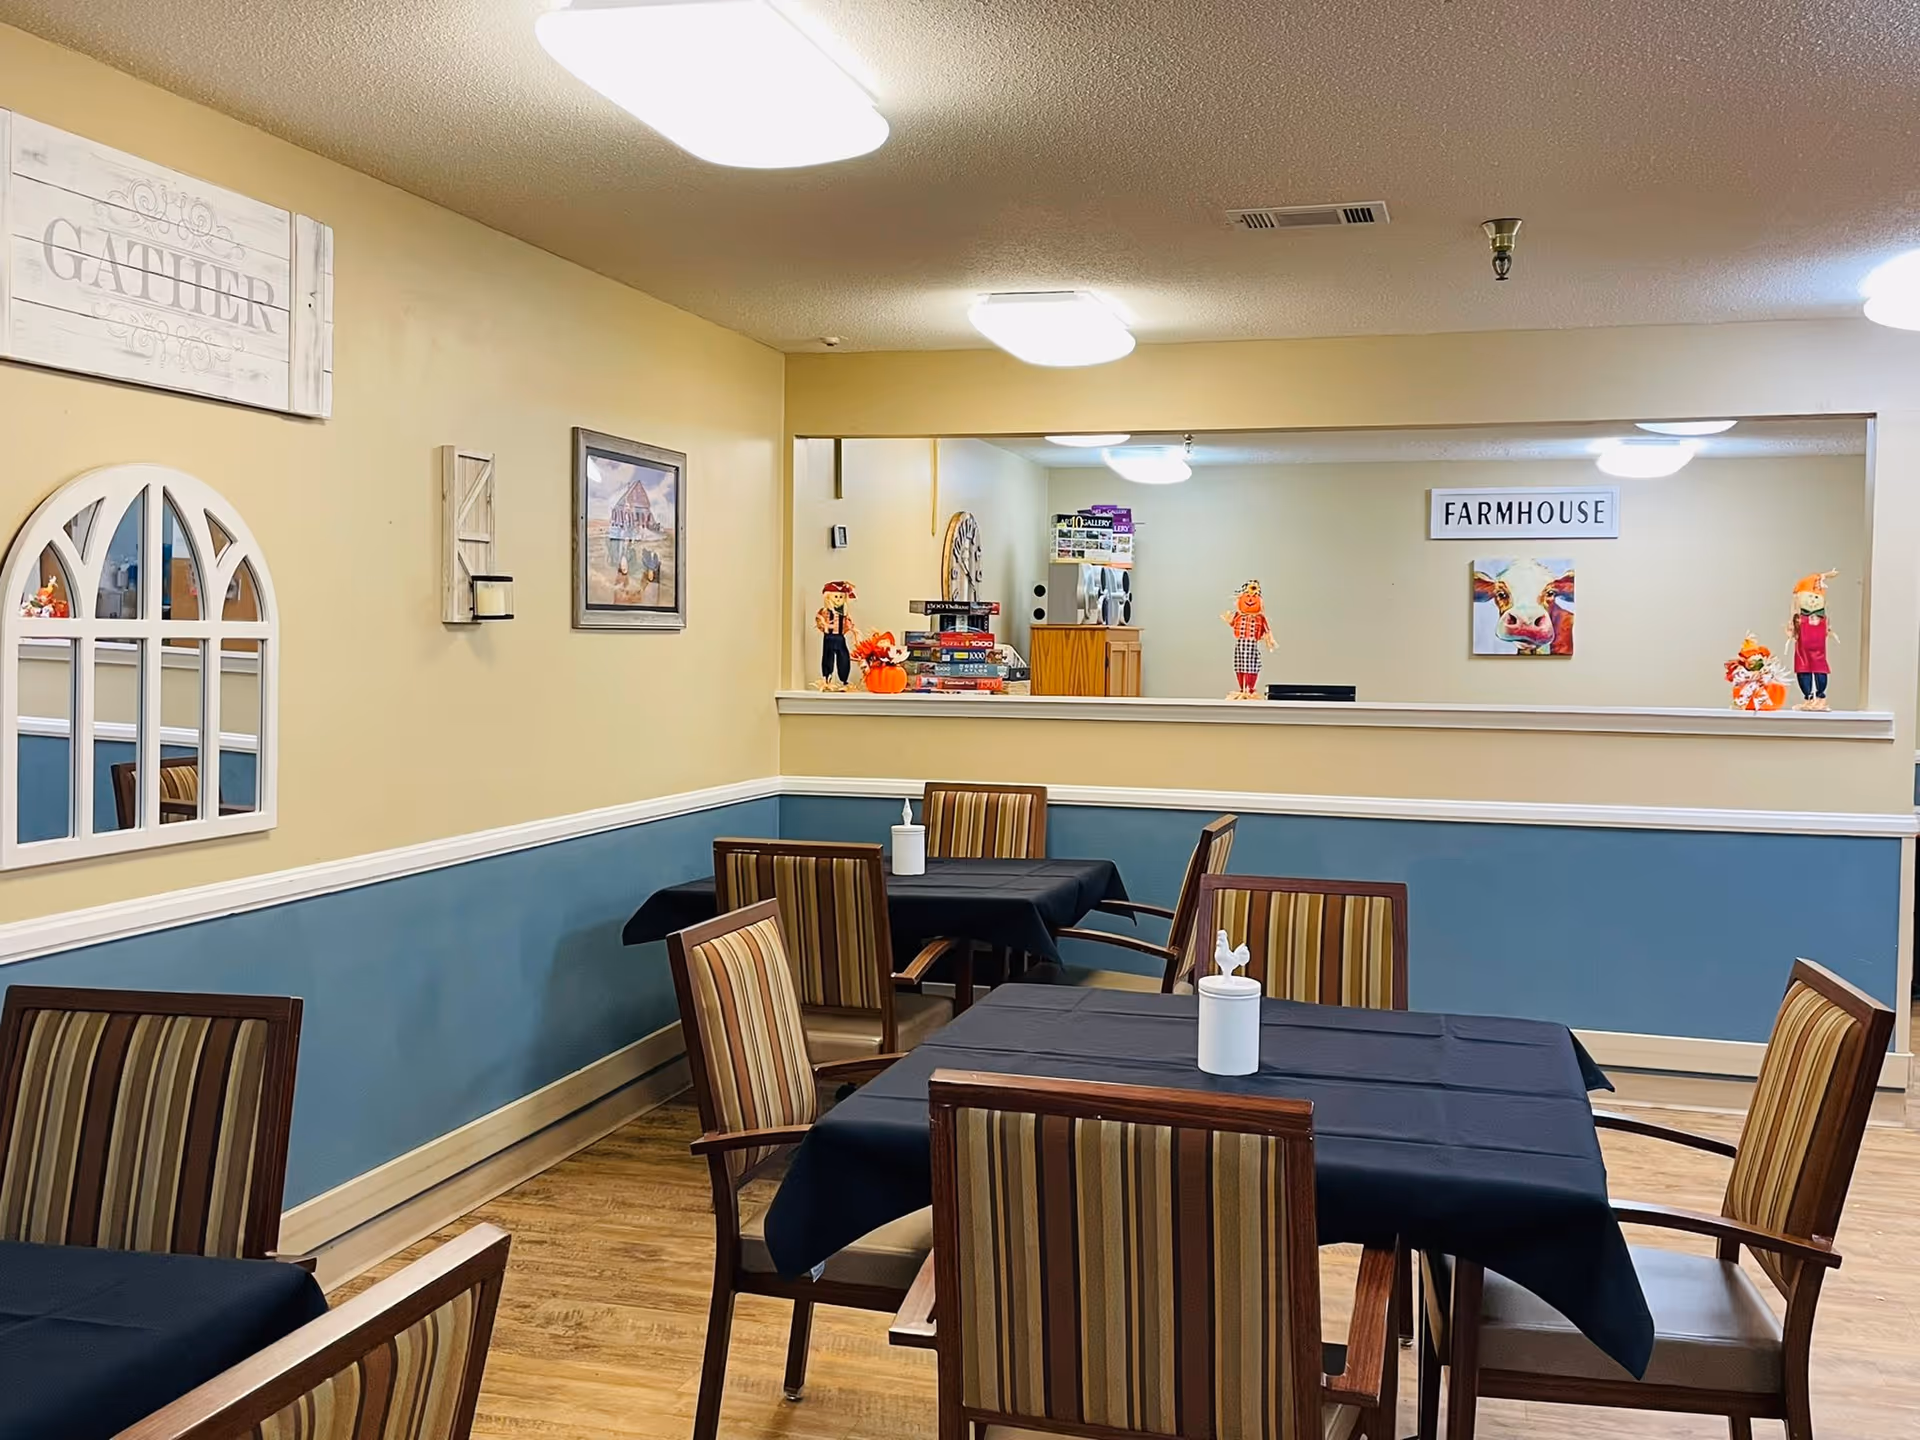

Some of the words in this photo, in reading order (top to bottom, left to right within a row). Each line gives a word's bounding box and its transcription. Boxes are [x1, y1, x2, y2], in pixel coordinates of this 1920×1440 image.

[43, 218, 279, 334] GATHER
[1072, 515, 1083, 528] 10
[1082, 519, 1111, 528] GALLERY
[1444, 500, 1605, 526] FARMHOUSE
